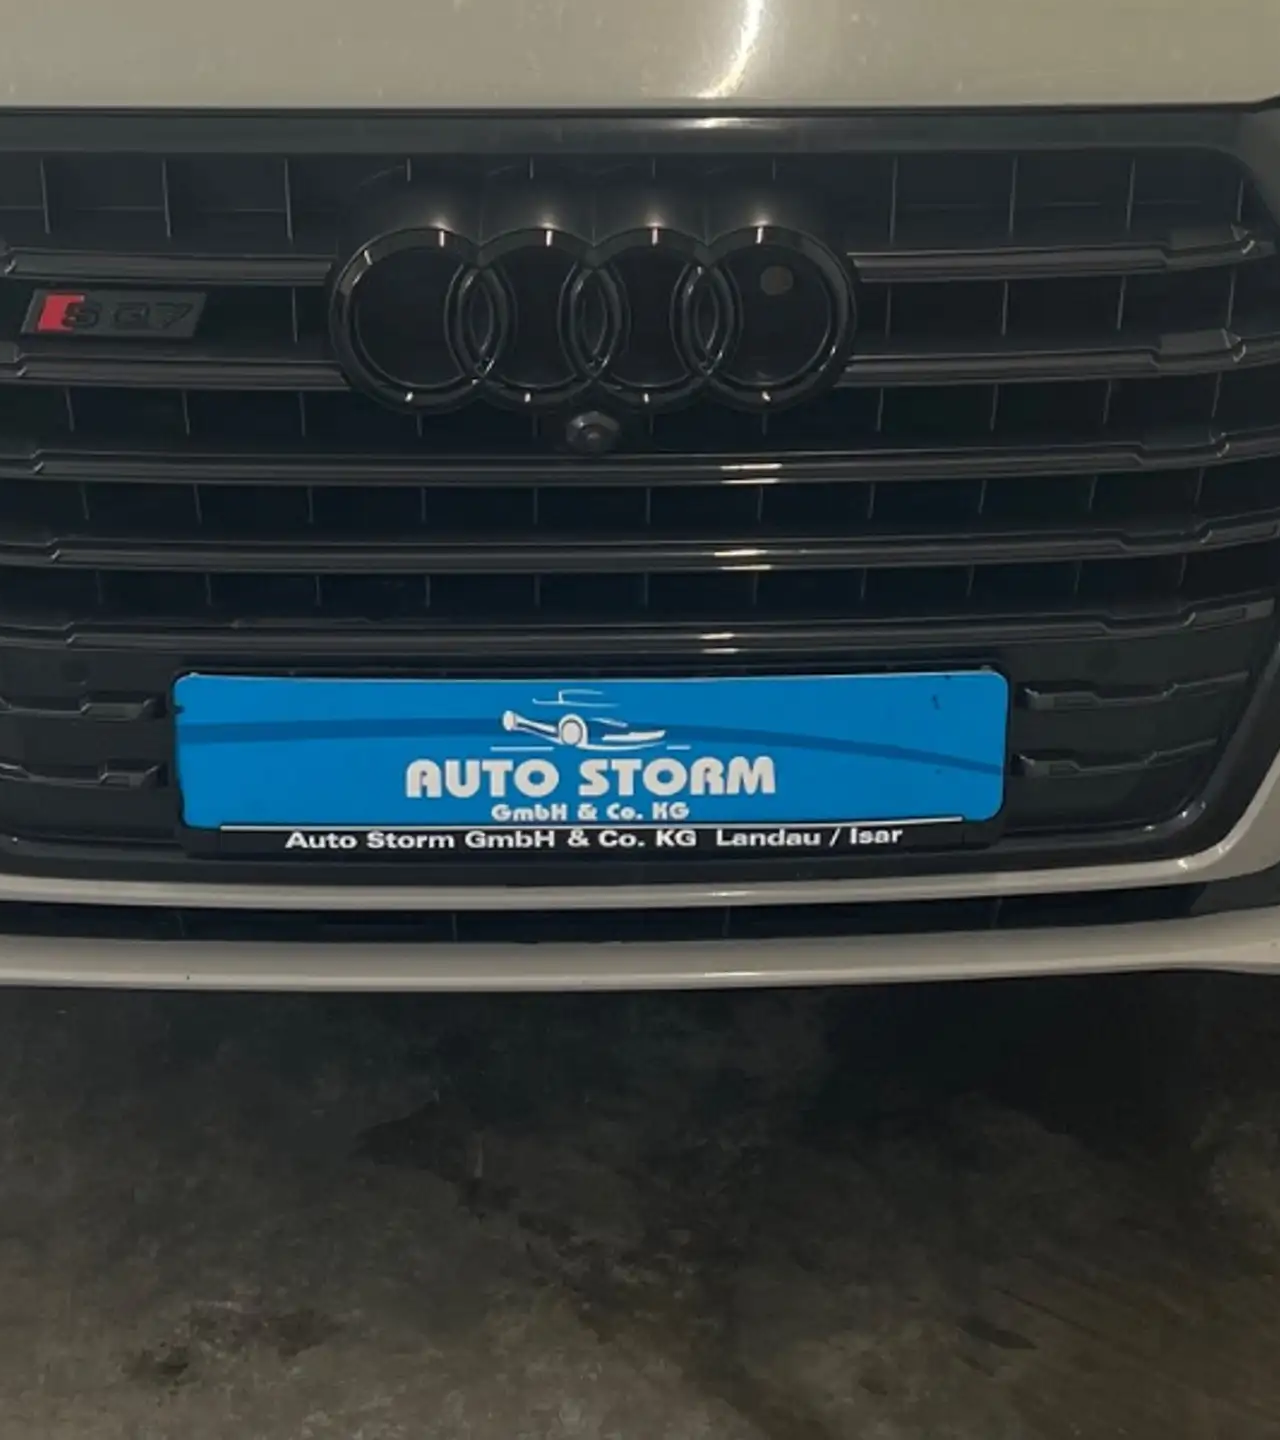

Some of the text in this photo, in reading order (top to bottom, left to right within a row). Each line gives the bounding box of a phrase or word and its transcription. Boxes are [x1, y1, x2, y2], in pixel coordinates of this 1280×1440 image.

[406, 756, 776, 798] AUTO STORM
[491, 802, 690, 821] GmbH & Co. KG
[285, 827, 903, 849] Auto Storm GmbH & Co. KG Landau / Isar
